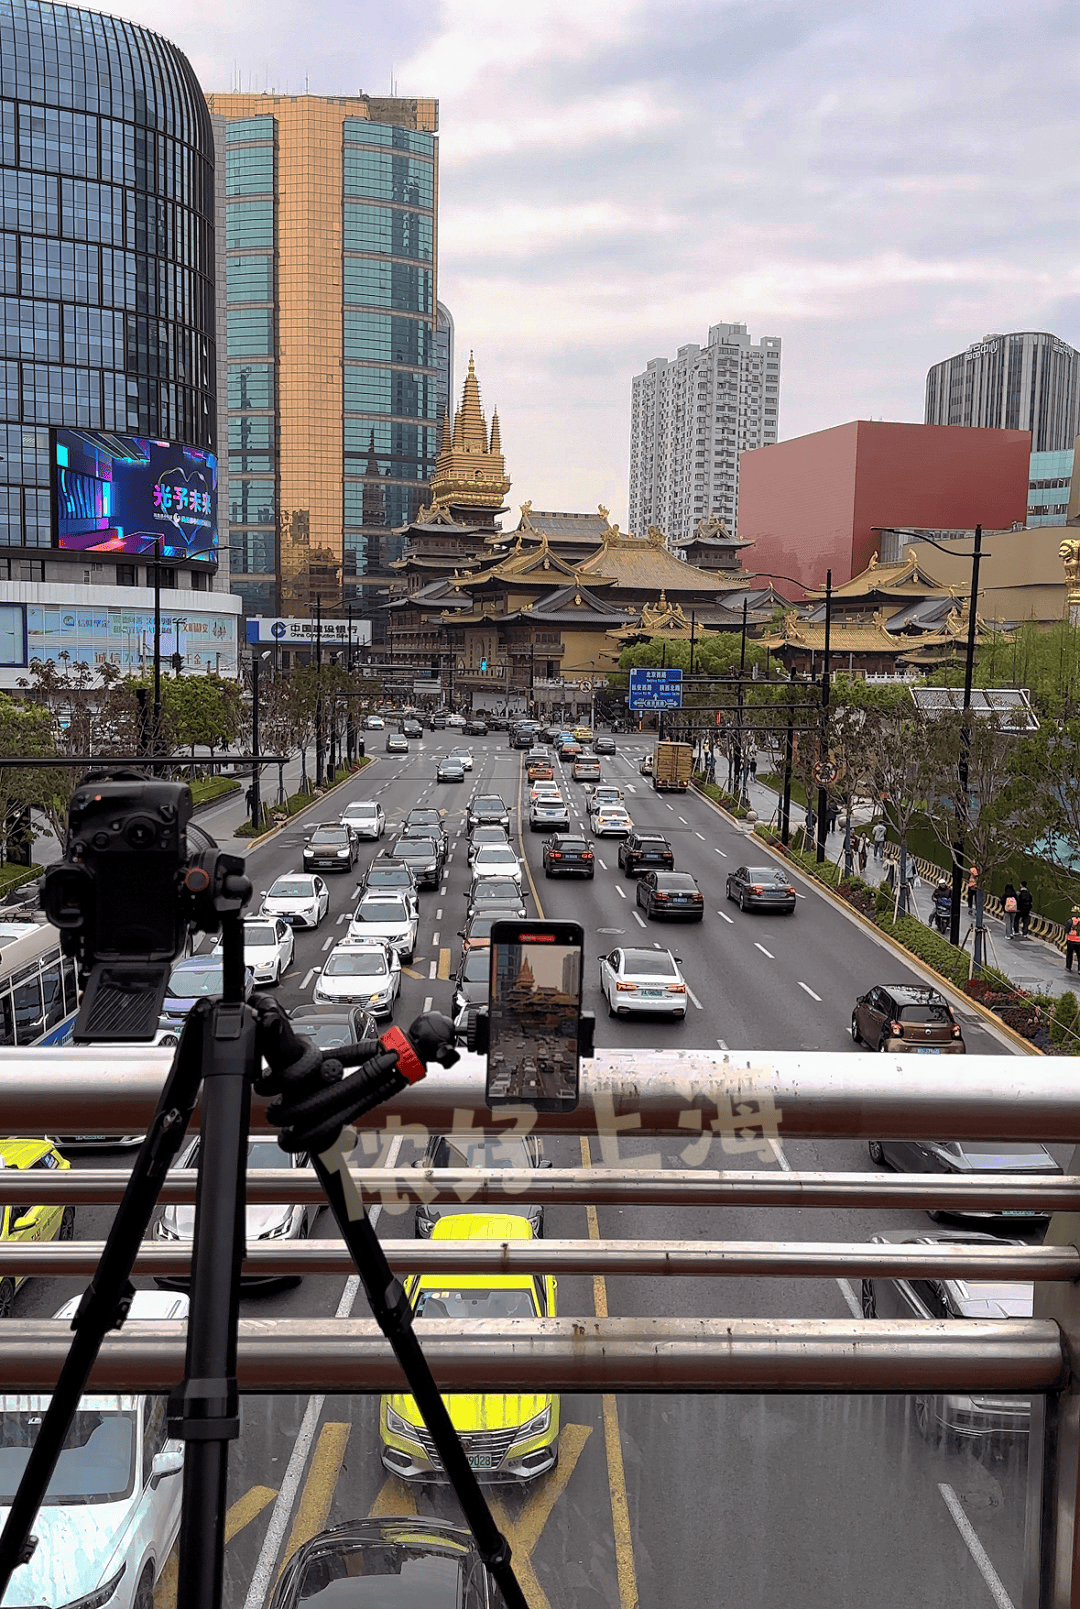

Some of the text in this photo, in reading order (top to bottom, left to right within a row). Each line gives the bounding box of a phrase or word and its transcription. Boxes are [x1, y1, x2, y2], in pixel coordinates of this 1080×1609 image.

[153, 484, 212, 515] 光予未来
[290, 624, 358, 633] 中国建设银行
